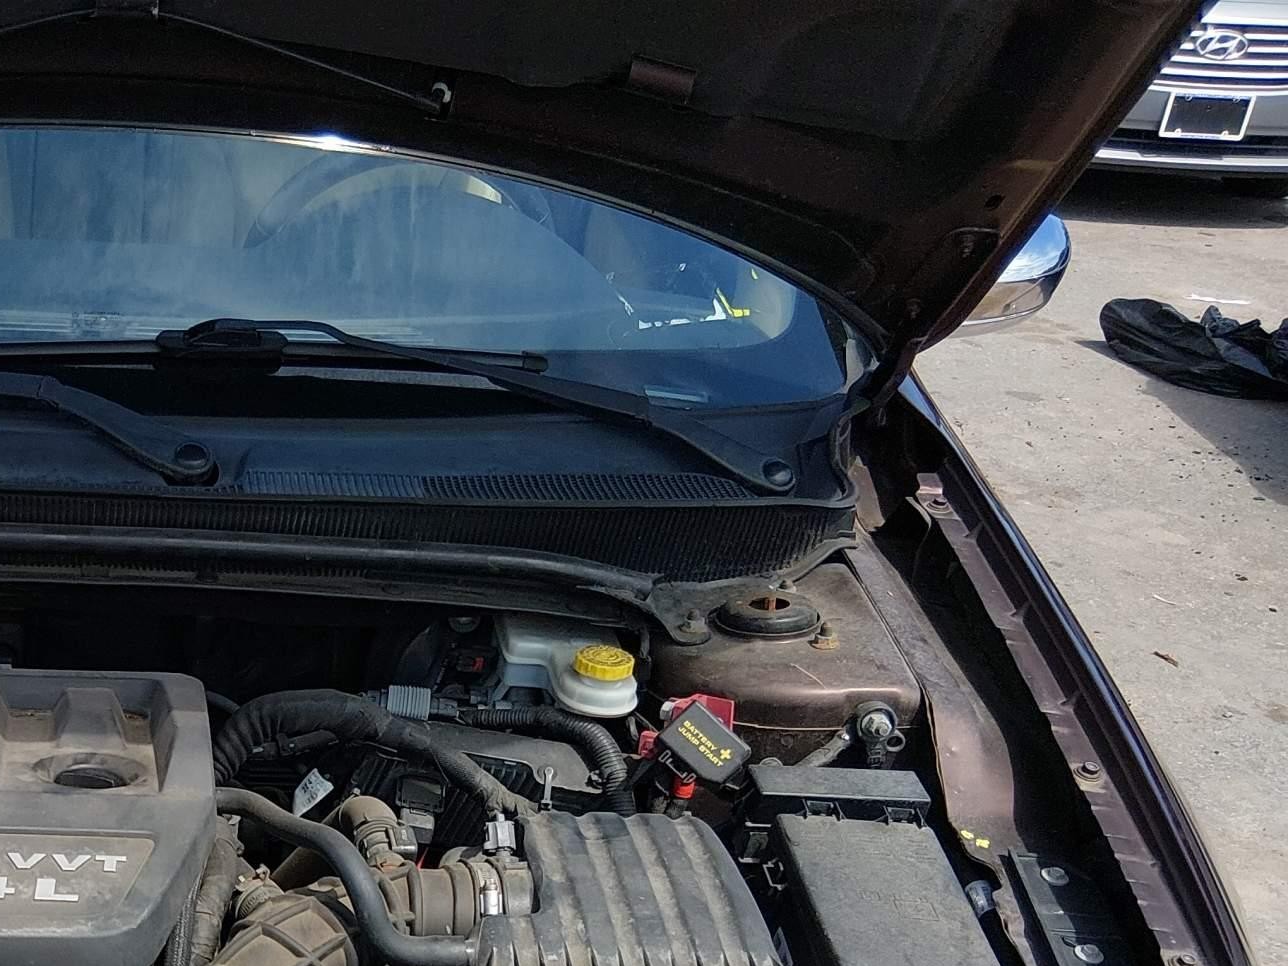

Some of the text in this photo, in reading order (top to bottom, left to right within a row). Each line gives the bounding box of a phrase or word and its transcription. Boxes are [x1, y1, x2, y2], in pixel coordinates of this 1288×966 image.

[678, 726, 724, 767] JUMP START
[683, 720, 718, 751] BATTERY
[7, 852, 127, 872] VVT
